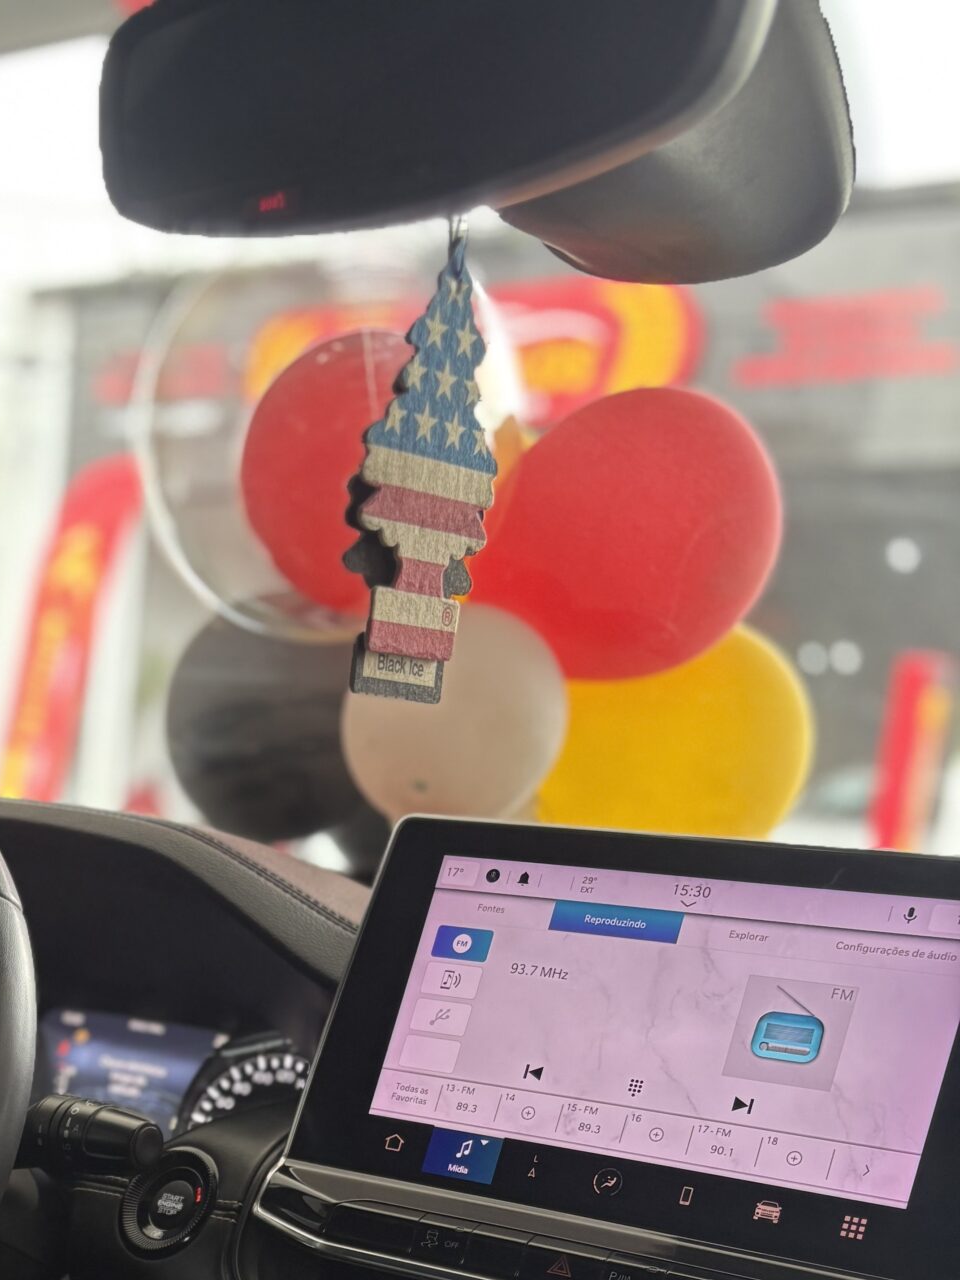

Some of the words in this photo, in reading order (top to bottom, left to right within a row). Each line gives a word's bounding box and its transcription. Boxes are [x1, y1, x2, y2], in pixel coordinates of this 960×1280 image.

[377, 653, 407, 676] Black
[409, 660, 424, 678] Ice
[580, 886, 595, 895] EXT
[673, 883, 712, 900] 15:30
[476, 903, 506, 914] Fontes
[583, 913, 647, 930] Reproduzindo
[728, 929, 770, 943] Explorar
[455, 938, 469, 948] FM
[835, 940, 910, 958] Configurações
[911, 949, 926, 959] de
[926, 950, 958, 963] áudio
[510, 962, 538, 977] 93.7
[539, 966, 570, 981] MHz
[831, 986, 855, 1002] FM
[395, 1082, 418, 1094] Todas
[417, 1087, 430, 1096] as
[505, 1093, 516, 1102] 14
[455, 1101, 478, 1114] 89.3
[631, 1113, 642, 1123] 16
[577, 1122, 601, 1135] 89.3
[767, 1136, 778, 1146] 18
[710, 1145, 734, 1157] 90.1
